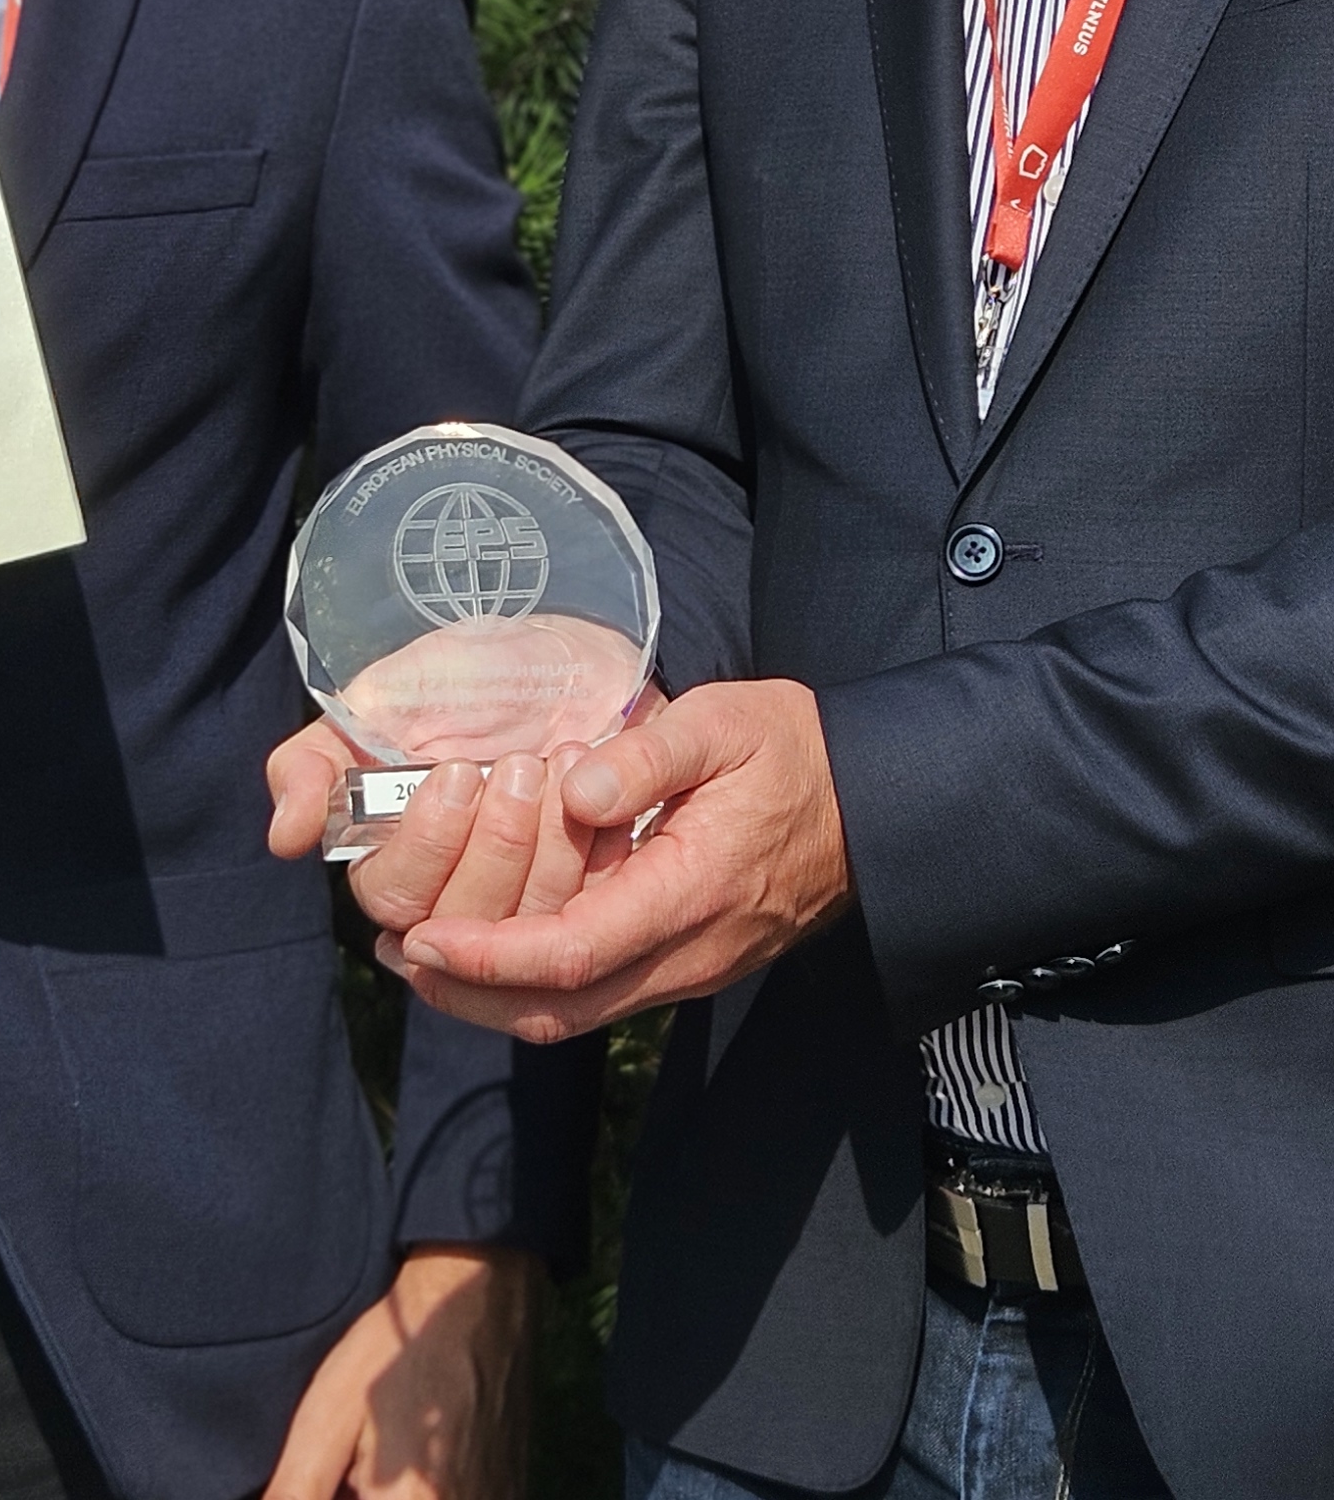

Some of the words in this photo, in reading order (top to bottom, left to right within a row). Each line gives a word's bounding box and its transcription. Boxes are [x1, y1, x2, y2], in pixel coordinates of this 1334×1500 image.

[344, 449, 425, 516] EUROPEAN
[424, 441, 511, 466] PHYSICAL
[515, 454, 583, 505] SOCIETY
[433, 515, 549, 561] EPS
